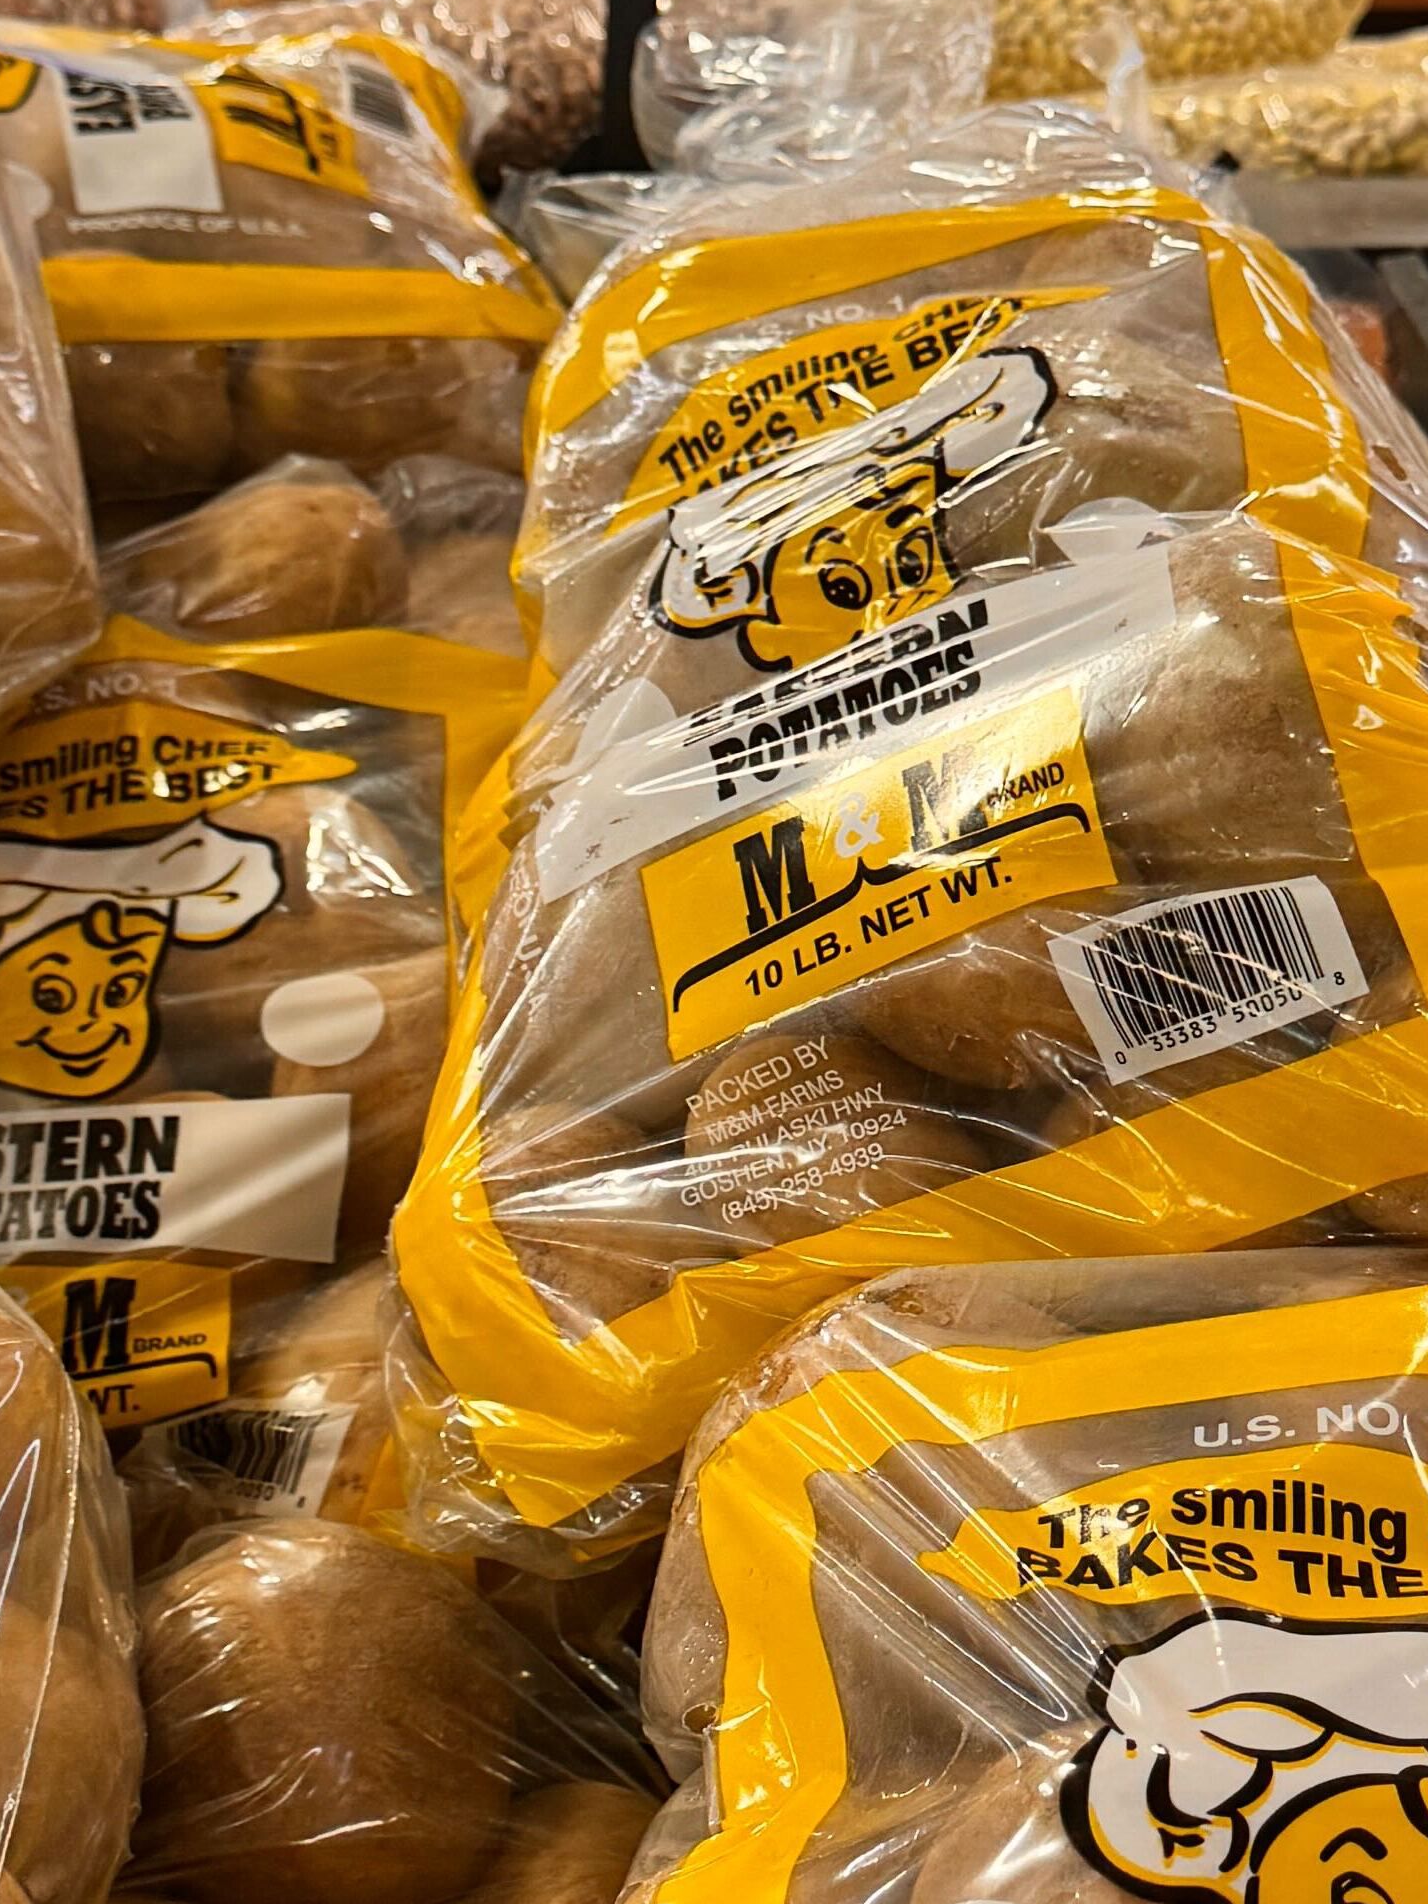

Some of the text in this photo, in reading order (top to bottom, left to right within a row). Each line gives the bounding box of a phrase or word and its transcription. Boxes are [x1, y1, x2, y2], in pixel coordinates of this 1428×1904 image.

[805, 304, 871, 329] NO.
[796, 297, 1026, 424] THE BEST
[659, 344, 880, 483] The smiling
[152, 735, 272, 766] CHEF
[61, 769, 147, 816] THE
[733, 814, 817, 939] M
[742, 855, 1016, 999] 10 LB. NET WT.
[1114, 971, 1346, 1065] 0 33383 8
[685, 1035, 829, 1119] PACKED BY
[831, 1082, 886, 1121] HWY
[703, 1069, 845, 1147] M&M FARMS
[841, 1109, 908, 1143] 10924
[780, 1143, 884, 1196] 258-4939
[132, 1333, 207, 1354] BRAND
[1194, 1414, 1295, 1449] U.S.
[1317, 1401, 1409, 1437] NO.
[1038, 1498, 1152, 1550] The
[1172, 1477, 1407, 1565] smiling
[1017, 1535, 1260, 1592] BAKES
